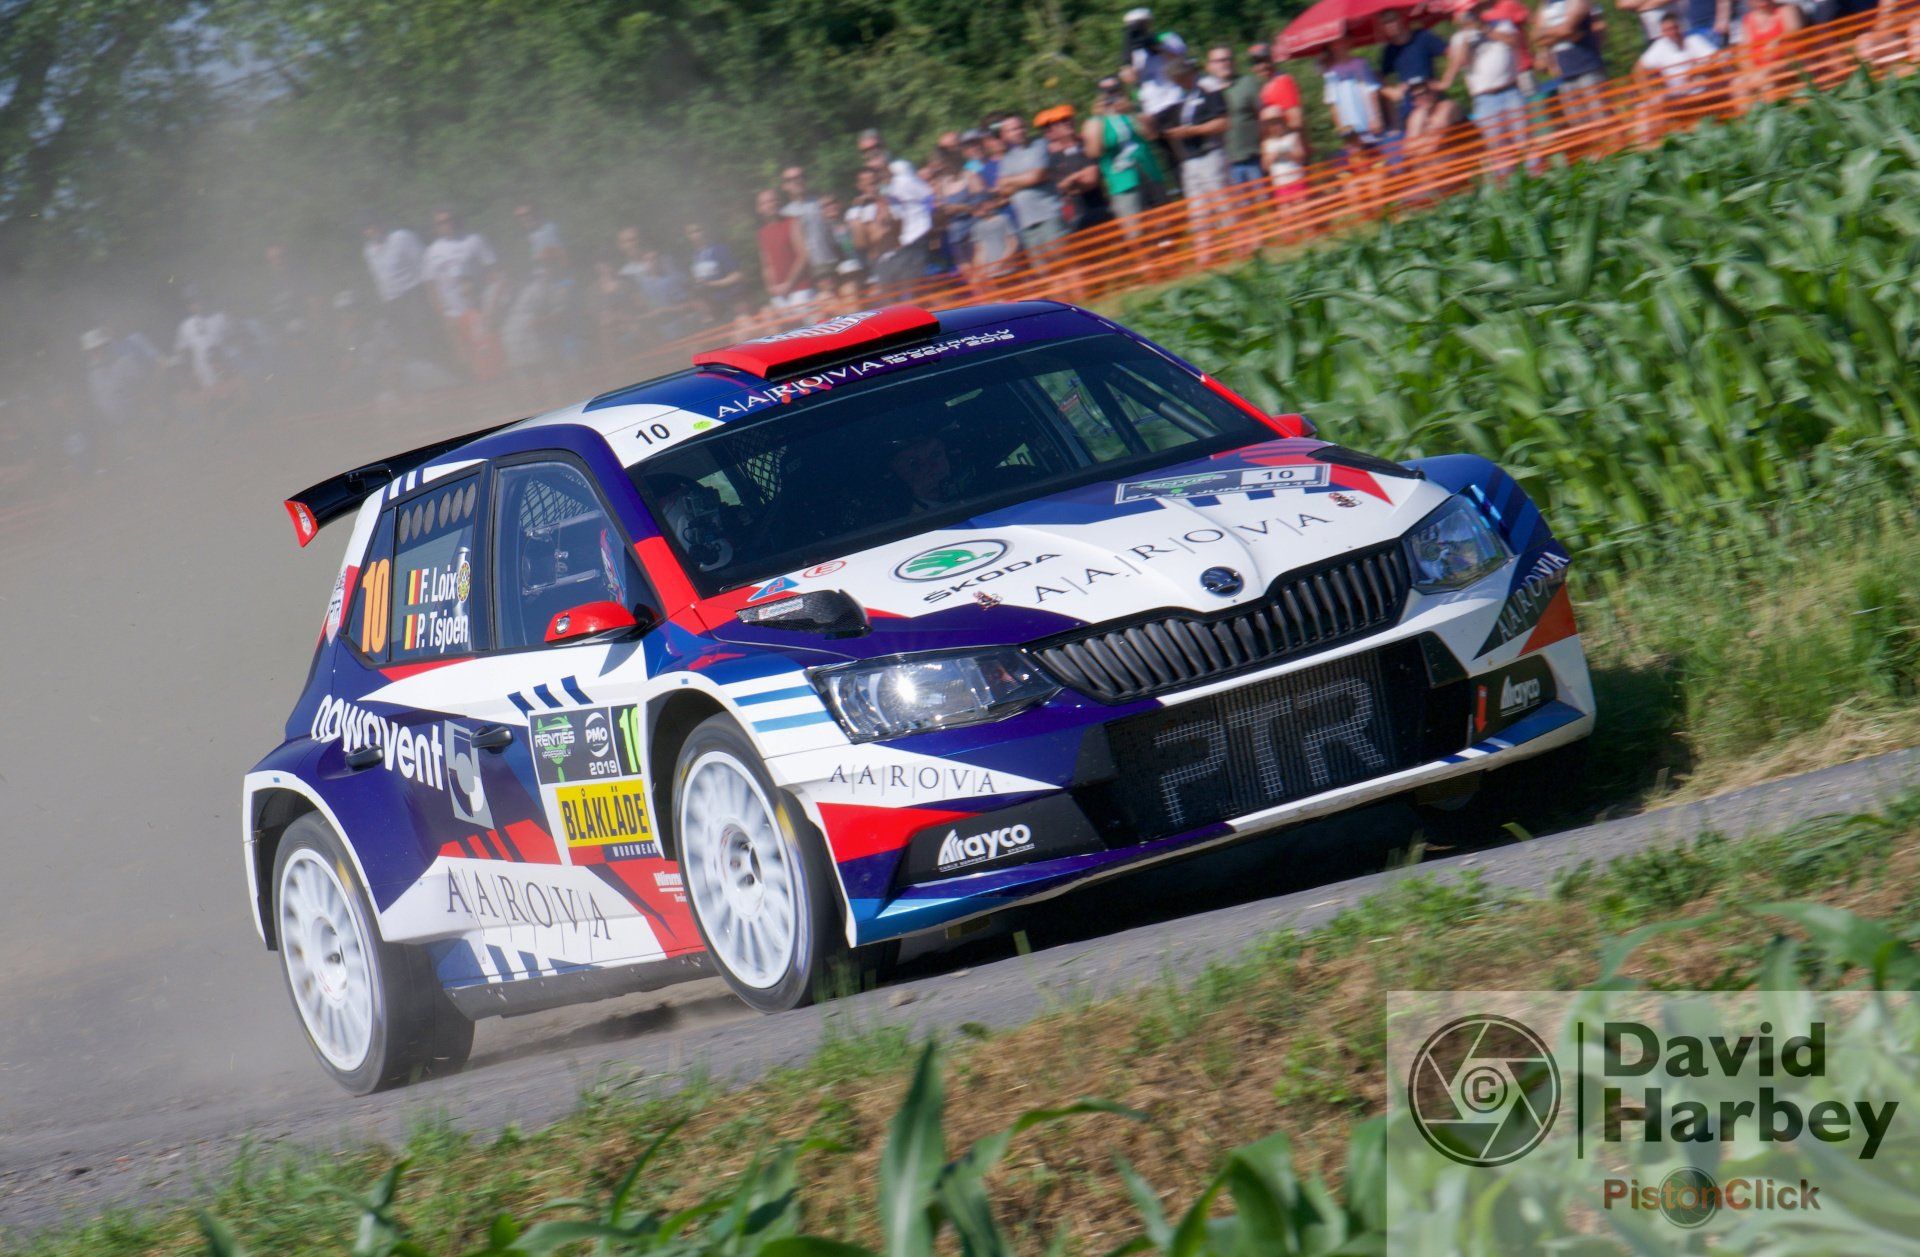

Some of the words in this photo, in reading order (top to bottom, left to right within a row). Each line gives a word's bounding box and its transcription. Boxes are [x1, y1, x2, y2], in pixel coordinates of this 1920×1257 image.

[635, 423, 670, 445] 10
[1263, 470, 1295, 480] 10
[420, 568, 429, 604] F.
[431, 564, 458, 603] Loix
[362, 558, 390, 653] 10
[415, 613, 425, 649] P.
[429, 609, 469, 654] Tsjoen
[534, 730, 575, 748] RENTIES
[585, 726, 608, 744] PMO
[1153, 677, 1386, 827] PTR
[588, 759, 618, 776] 2019
